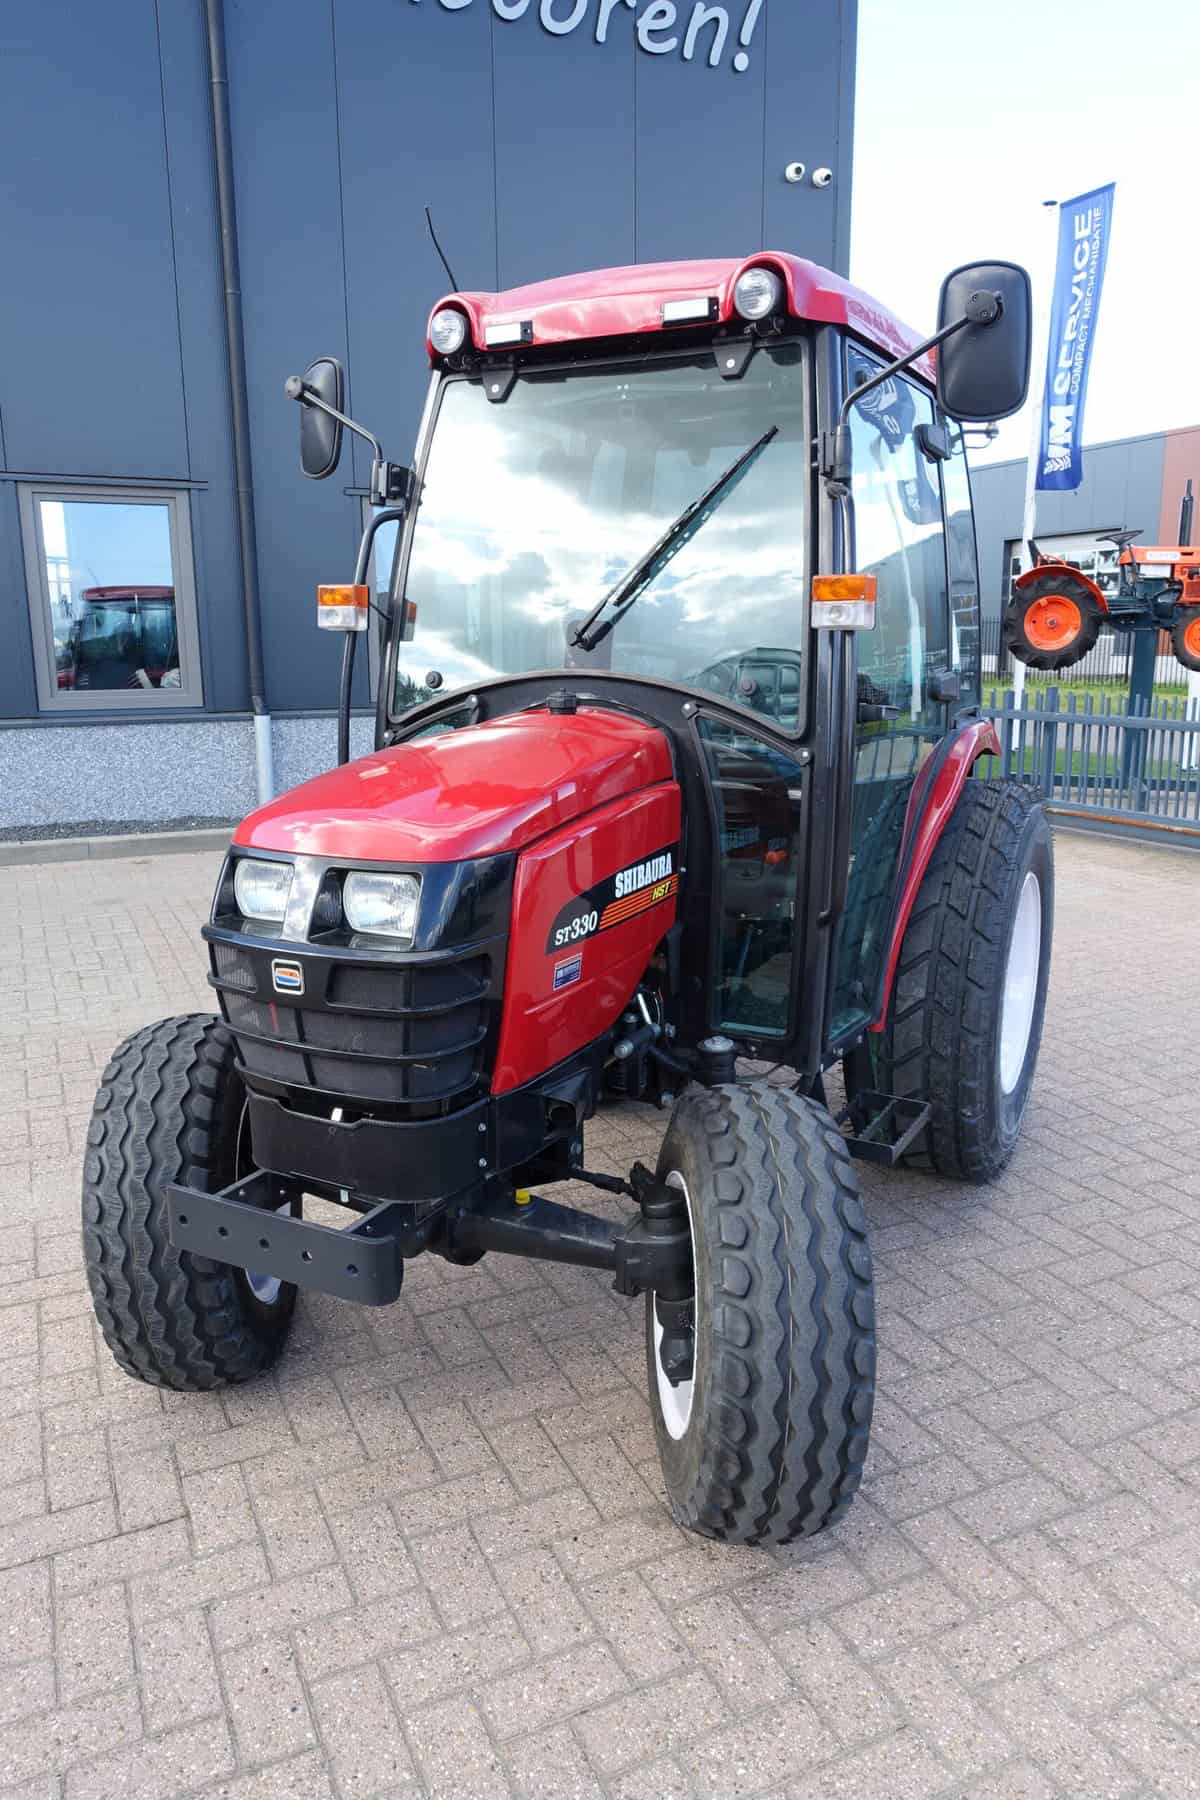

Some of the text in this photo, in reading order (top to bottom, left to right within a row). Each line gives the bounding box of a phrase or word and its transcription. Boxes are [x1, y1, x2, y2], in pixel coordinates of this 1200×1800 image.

[1053, 208, 1093, 395] SERVICE
[1070, 324, 1089, 395] COMPACT
[614, 852, 673, 899] SHIBAURA
[554, 910, 598, 946] ST330
